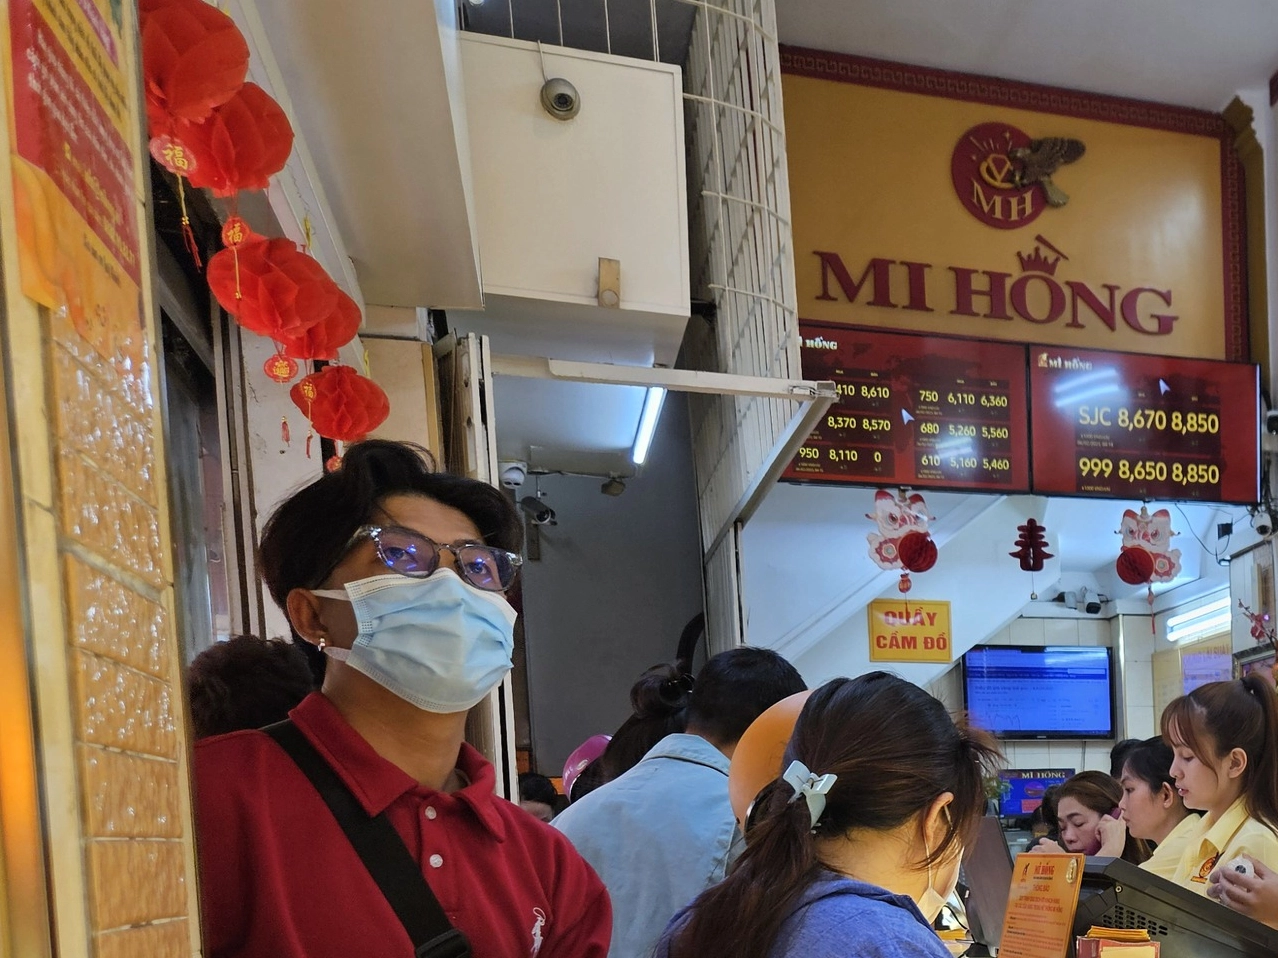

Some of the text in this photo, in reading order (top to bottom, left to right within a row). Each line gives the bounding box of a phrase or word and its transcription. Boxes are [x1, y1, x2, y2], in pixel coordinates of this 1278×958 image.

[972, 178, 1034, 222] MH
[948, 234, 1179, 336] HỒNG
[836, 384, 890, 399] 410 8,610
[919, 390, 1007, 408] 750 6,110 6,360
[827, 416, 891, 431] 8,370 8,570
[1078, 405, 1219, 435] SJC 8,670 8,850
[920, 422, 1008, 439] 680 5,260 5,560
[799, 447, 882, 463] 950 8,110 0
[921, 454, 1010, 471] 610 5,160 5,460
[1079, 457, 1220, 486] 999 8,650 8,850
[884, 607, 938, 627] QUẦY
[876, 631, 947, 650] CẦM ĐỒ
